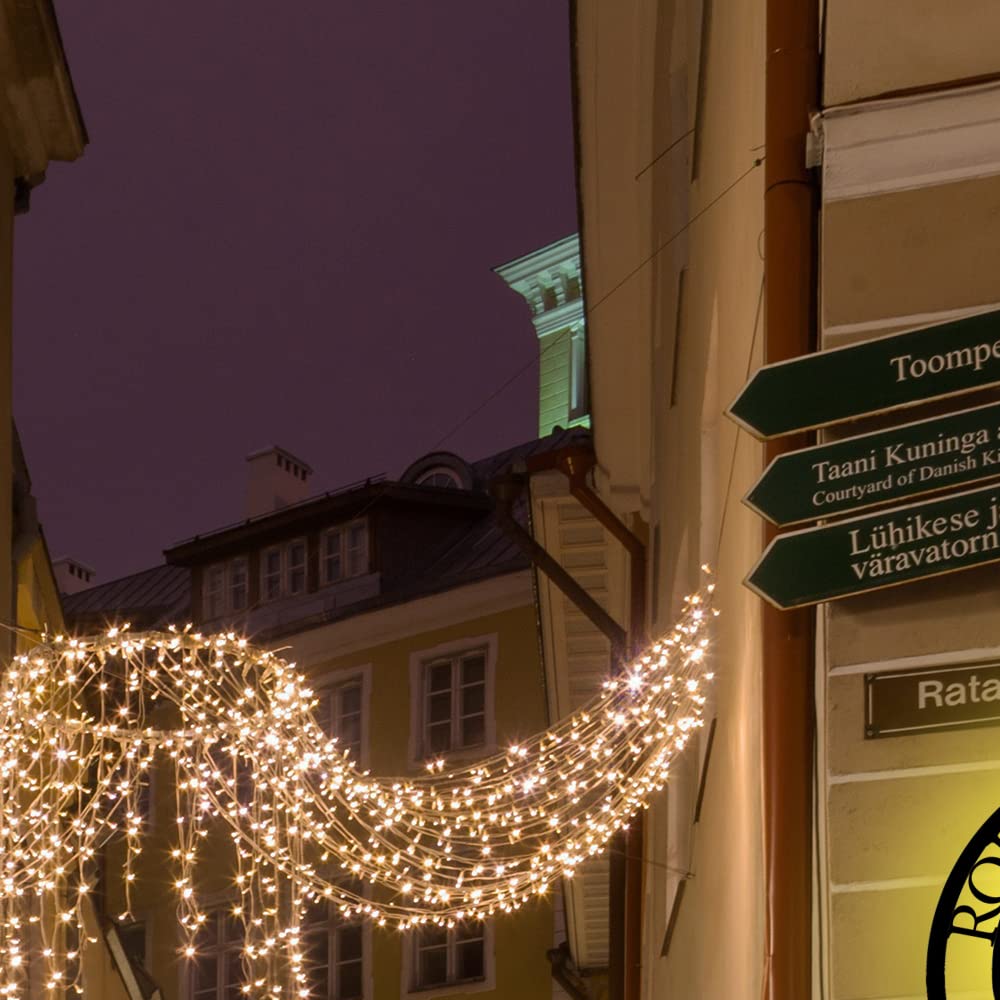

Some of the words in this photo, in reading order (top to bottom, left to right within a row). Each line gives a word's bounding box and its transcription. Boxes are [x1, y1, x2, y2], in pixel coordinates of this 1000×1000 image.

[812, 450, 877, 484] Taani
[885, 428, 989, 468] Kuninga
[812, 475, 893, 506] Courtyard
[897, 469, 917, 486] of
[919, 456, 977, 481] Danish
[848, 506, 980, 556] Lühikese
[851, 530, 1000, 580] väravatorn
